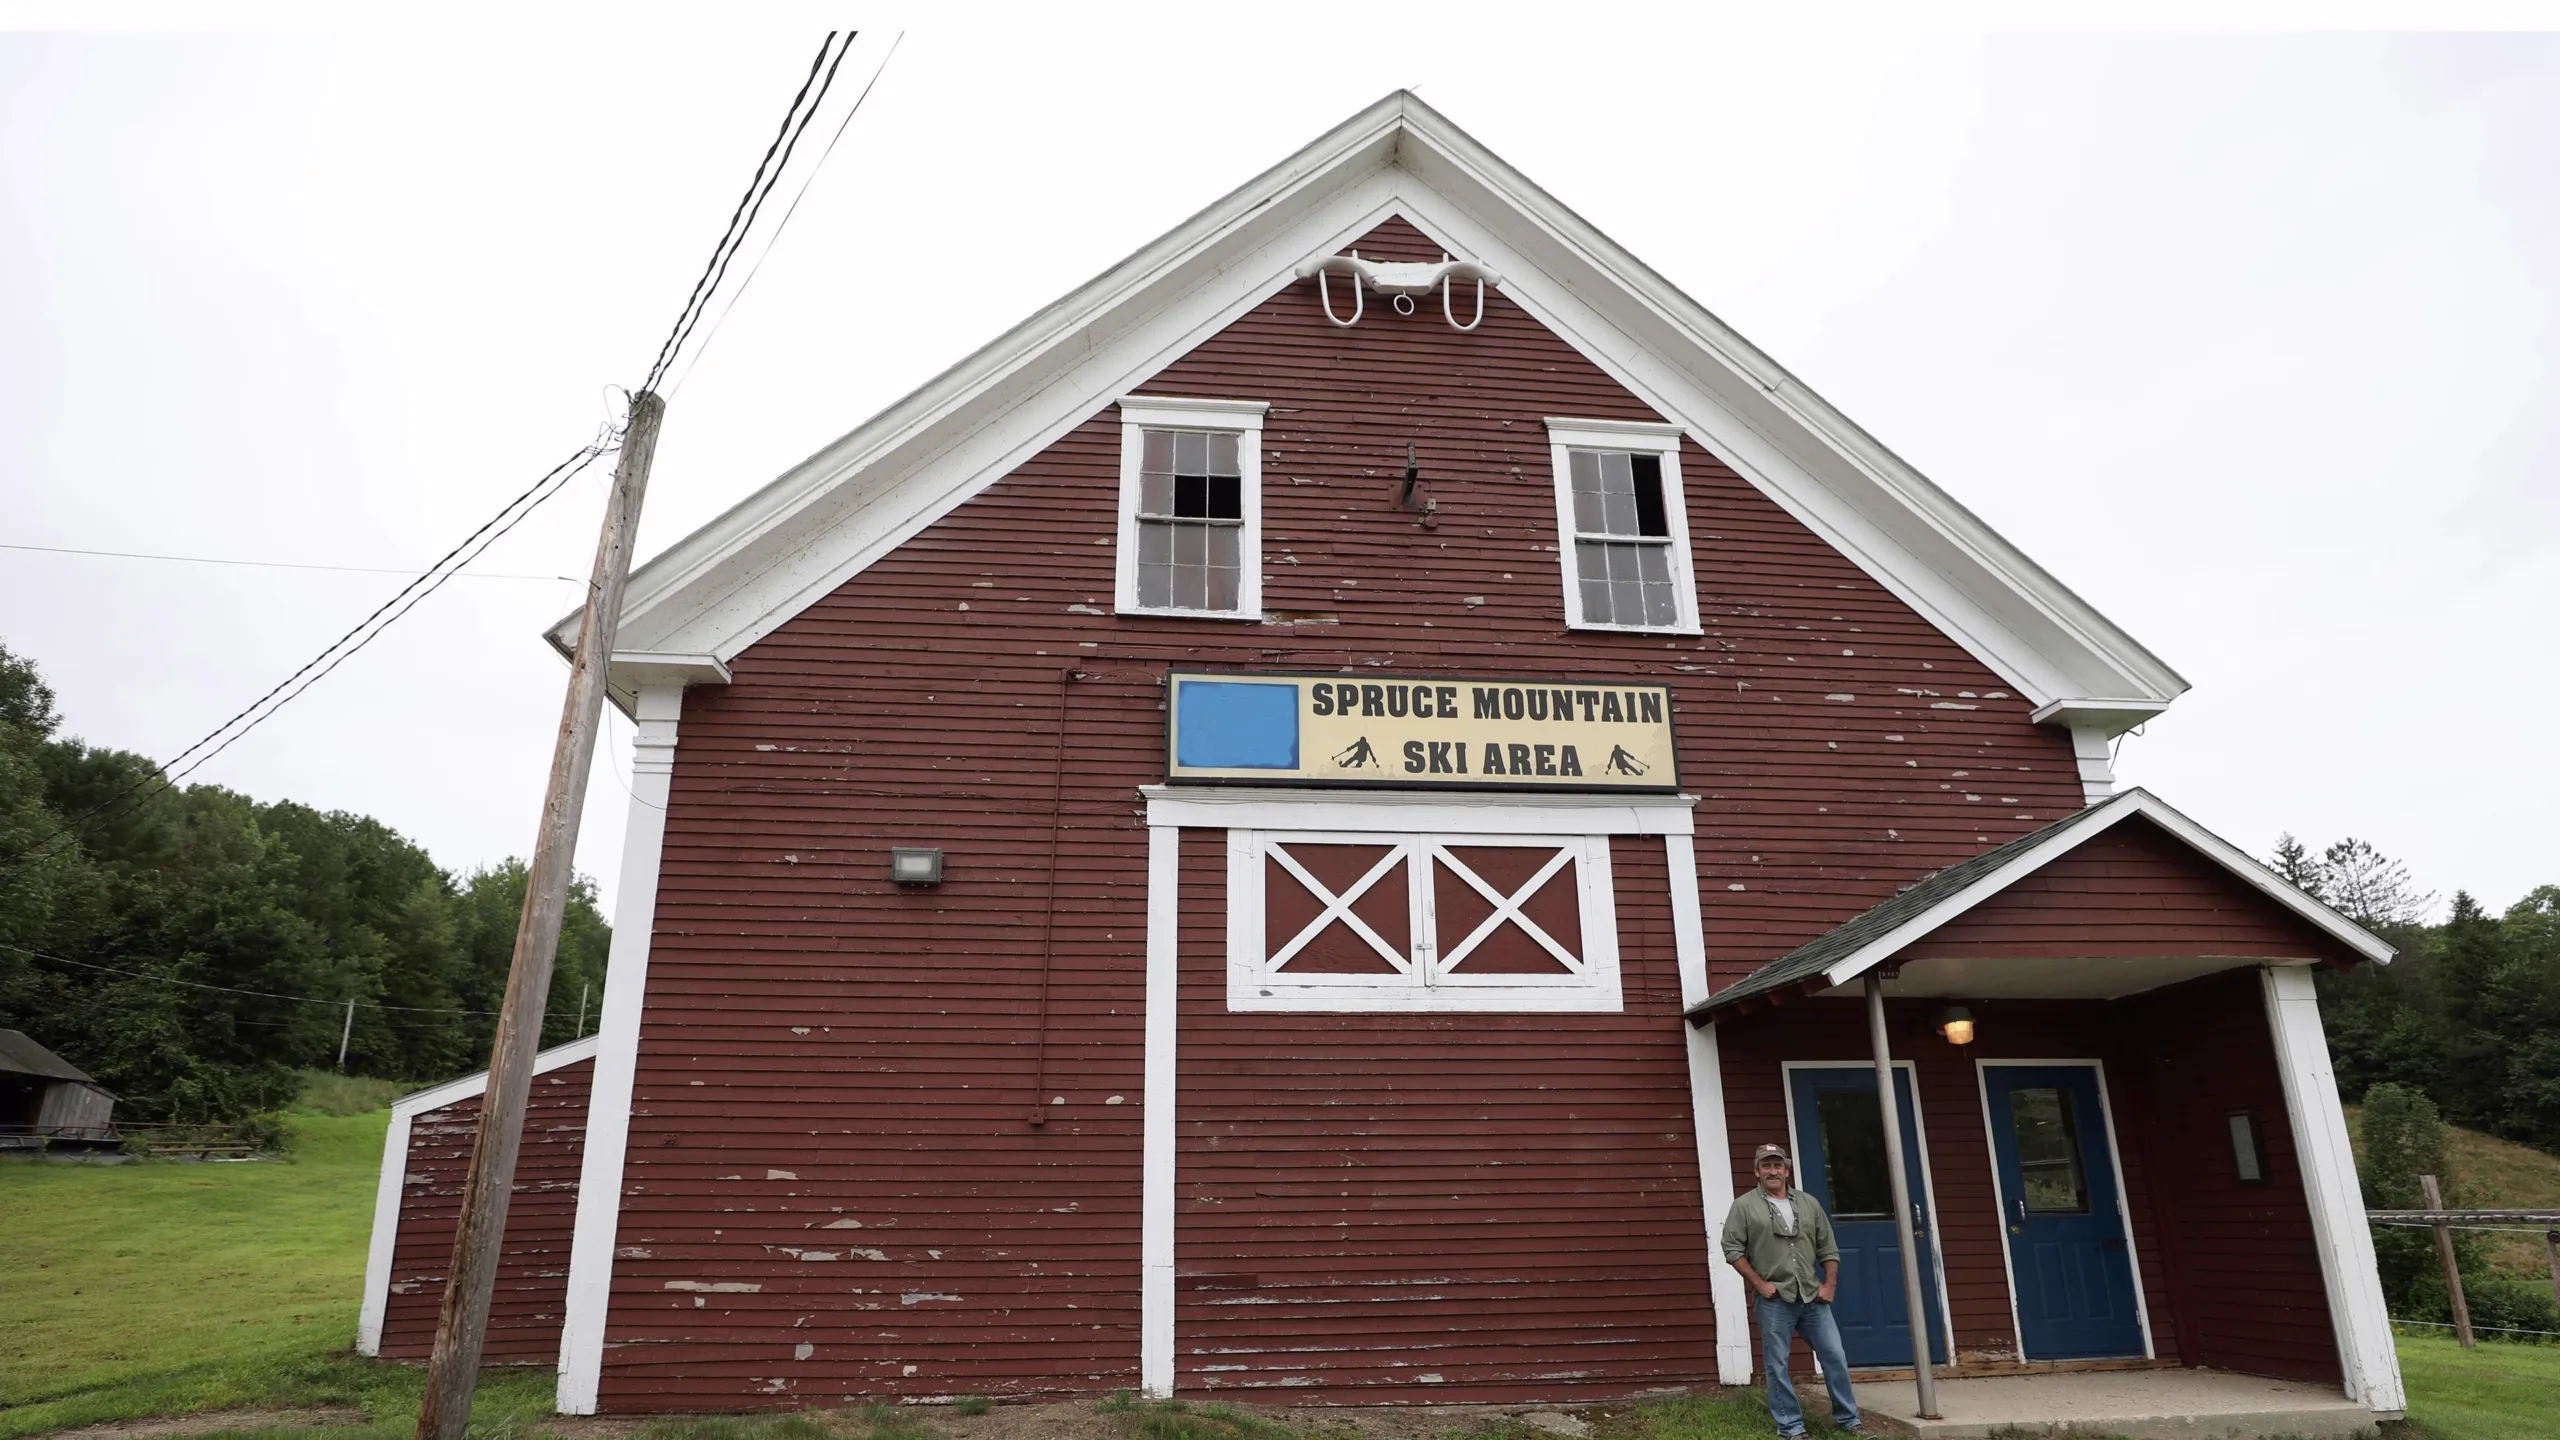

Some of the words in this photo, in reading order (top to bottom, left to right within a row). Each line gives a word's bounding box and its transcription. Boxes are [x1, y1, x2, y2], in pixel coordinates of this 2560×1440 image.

[1312, 683, 1458, 719] SPRUCE
[1473, 688, 1663, 724] MOUNTAIN
[1403, 741, 1468, 774] SKI
[1483, 743, 1583, 777] AREA
